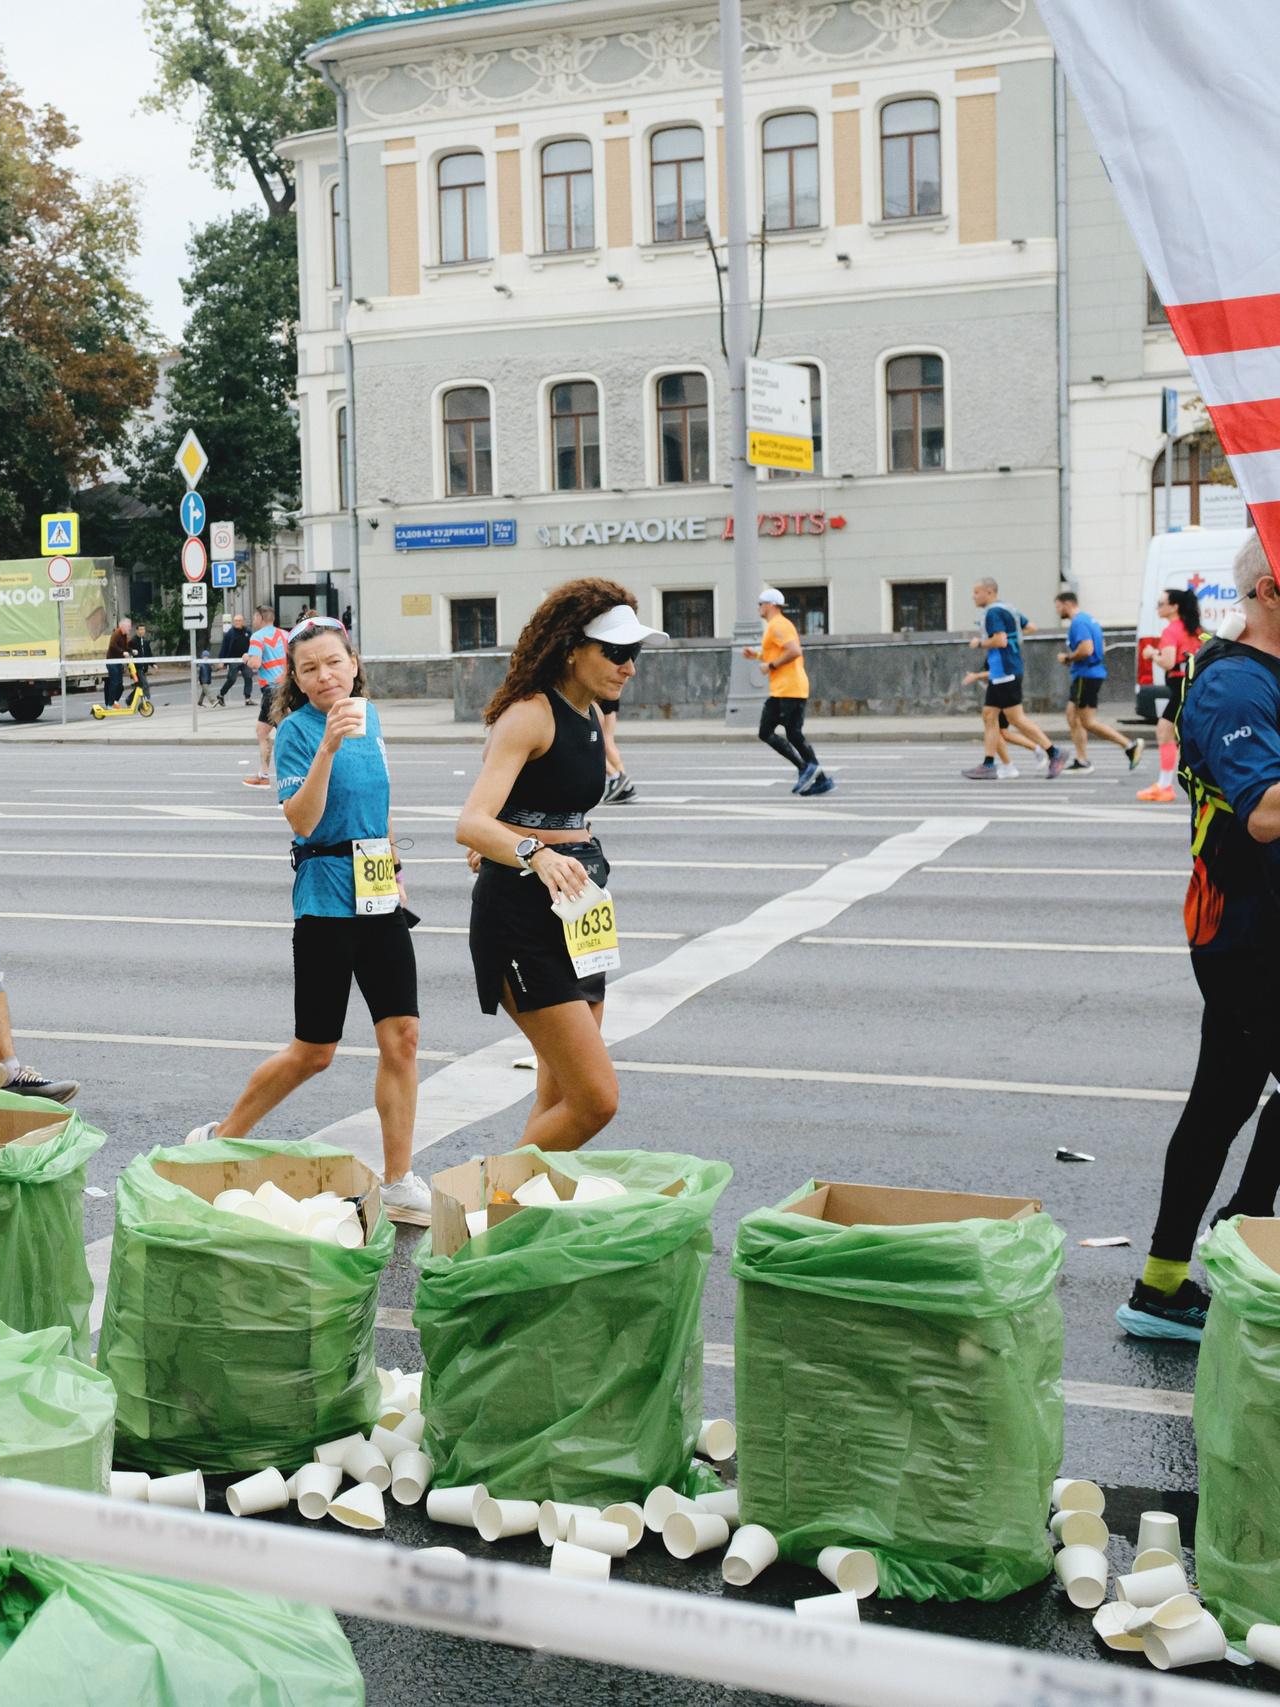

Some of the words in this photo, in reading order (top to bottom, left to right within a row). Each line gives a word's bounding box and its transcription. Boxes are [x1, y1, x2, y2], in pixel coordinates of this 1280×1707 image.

[396, 527, 485, 539] САДОВАЯ-КУДРИНСКАЯ
[559, 517, 707, 547] КАРАОКЕ
[218, 535, 228, 544] 30
[363, 858, 394, 882] 8082
[365, 900, 373, 913] G
